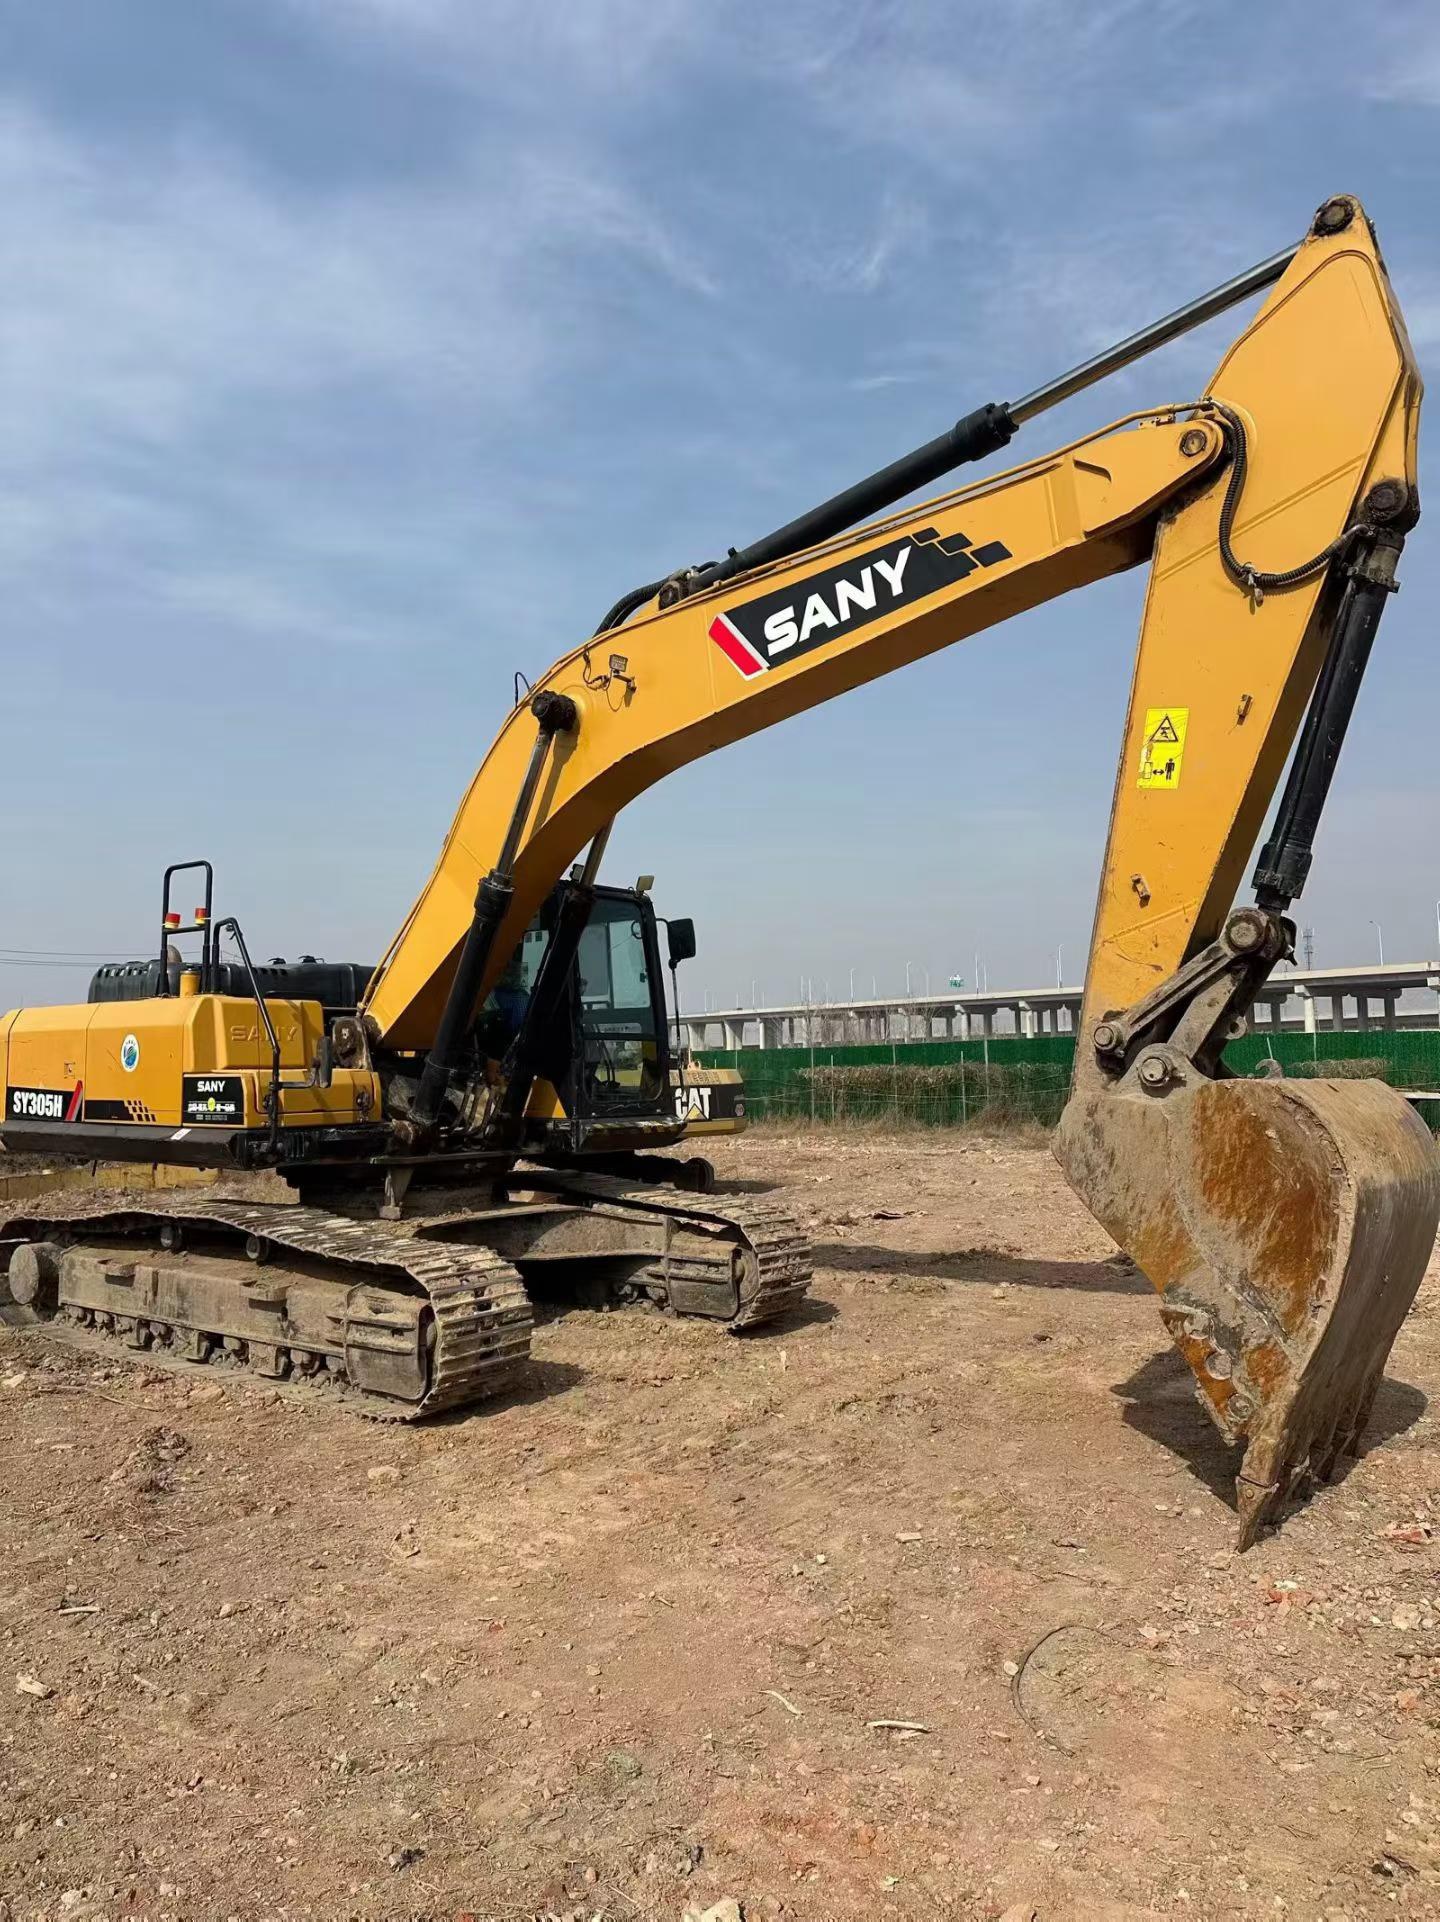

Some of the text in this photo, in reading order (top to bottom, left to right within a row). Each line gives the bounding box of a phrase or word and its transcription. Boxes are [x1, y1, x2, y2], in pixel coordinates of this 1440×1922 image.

[764, 545, 912, 656] SANY
[197, 1080, 226, 1092] SANY
[13, 1091, 63, 1118] SY305H
[675, 1087, 712, 1120] CAT
